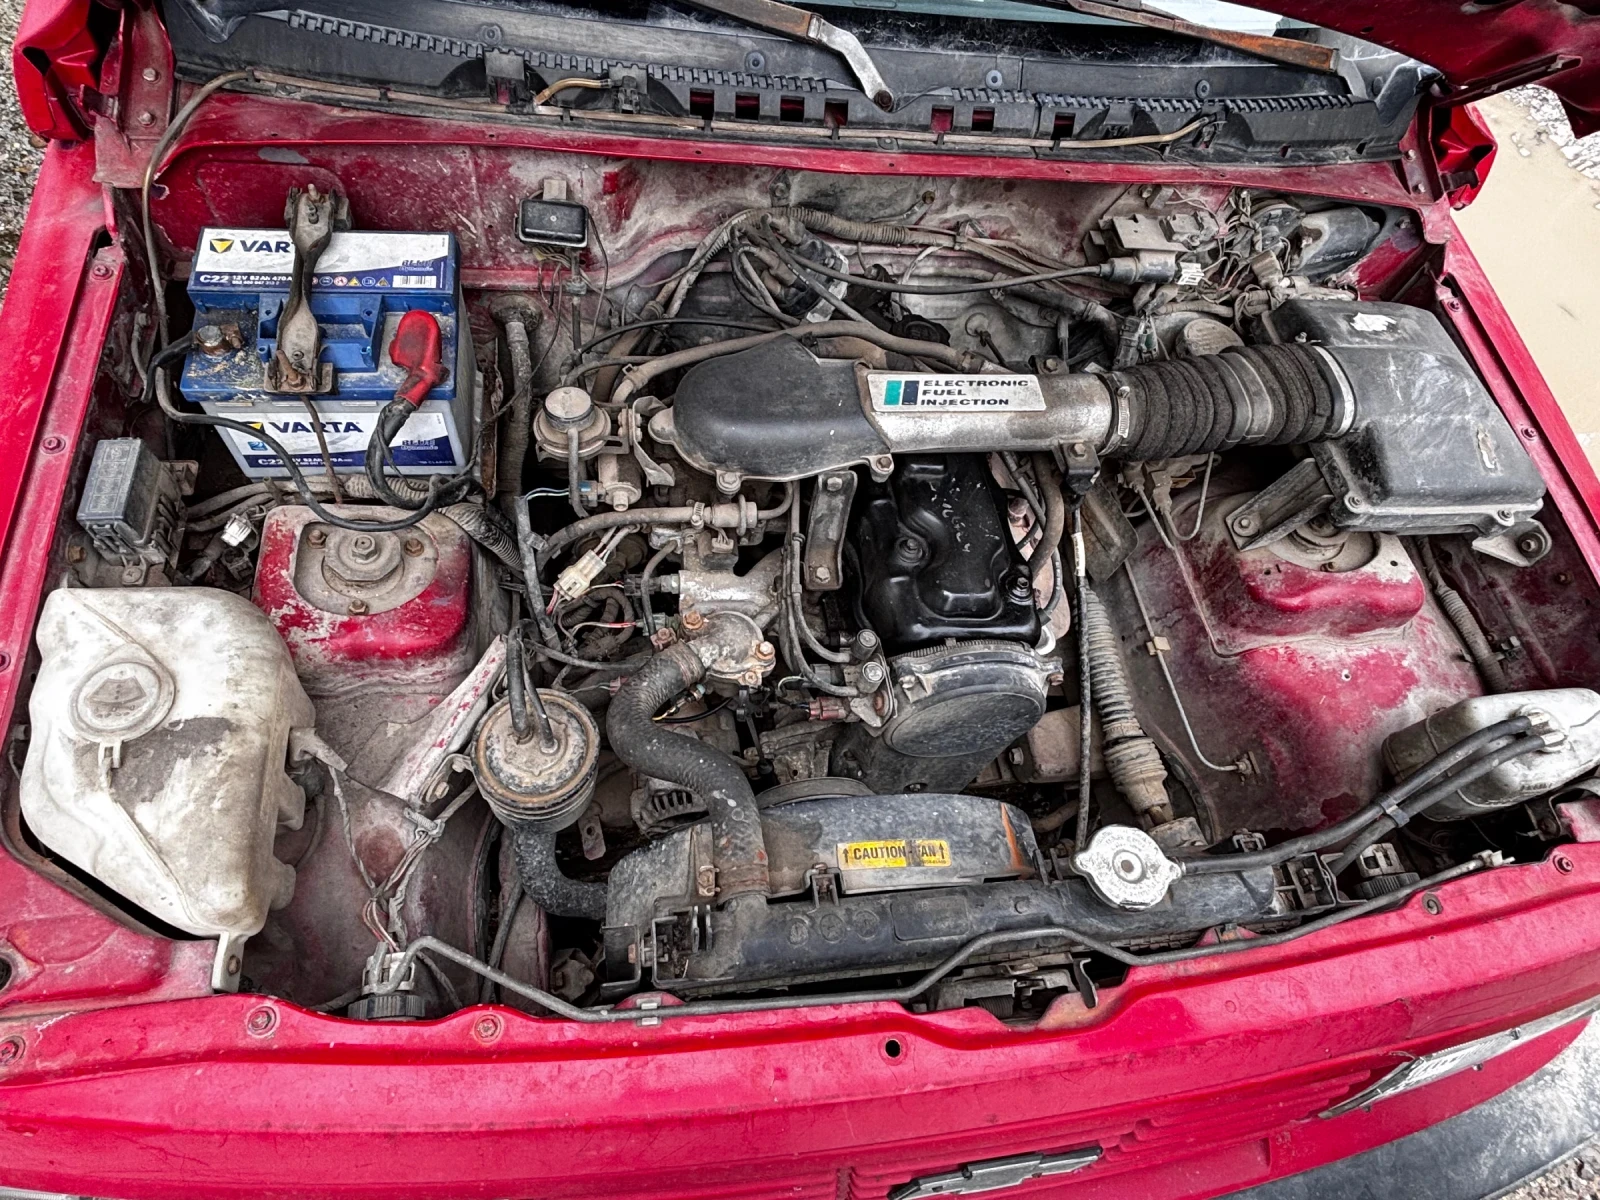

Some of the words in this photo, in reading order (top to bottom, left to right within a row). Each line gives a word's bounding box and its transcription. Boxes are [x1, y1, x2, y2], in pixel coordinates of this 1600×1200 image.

[240, 240, 294, 253] VAR
[200, 275, 229, 284] C22
[920, 398, 1009, 406] INJECTION
[853, 845, 907, 861] CAUTION
